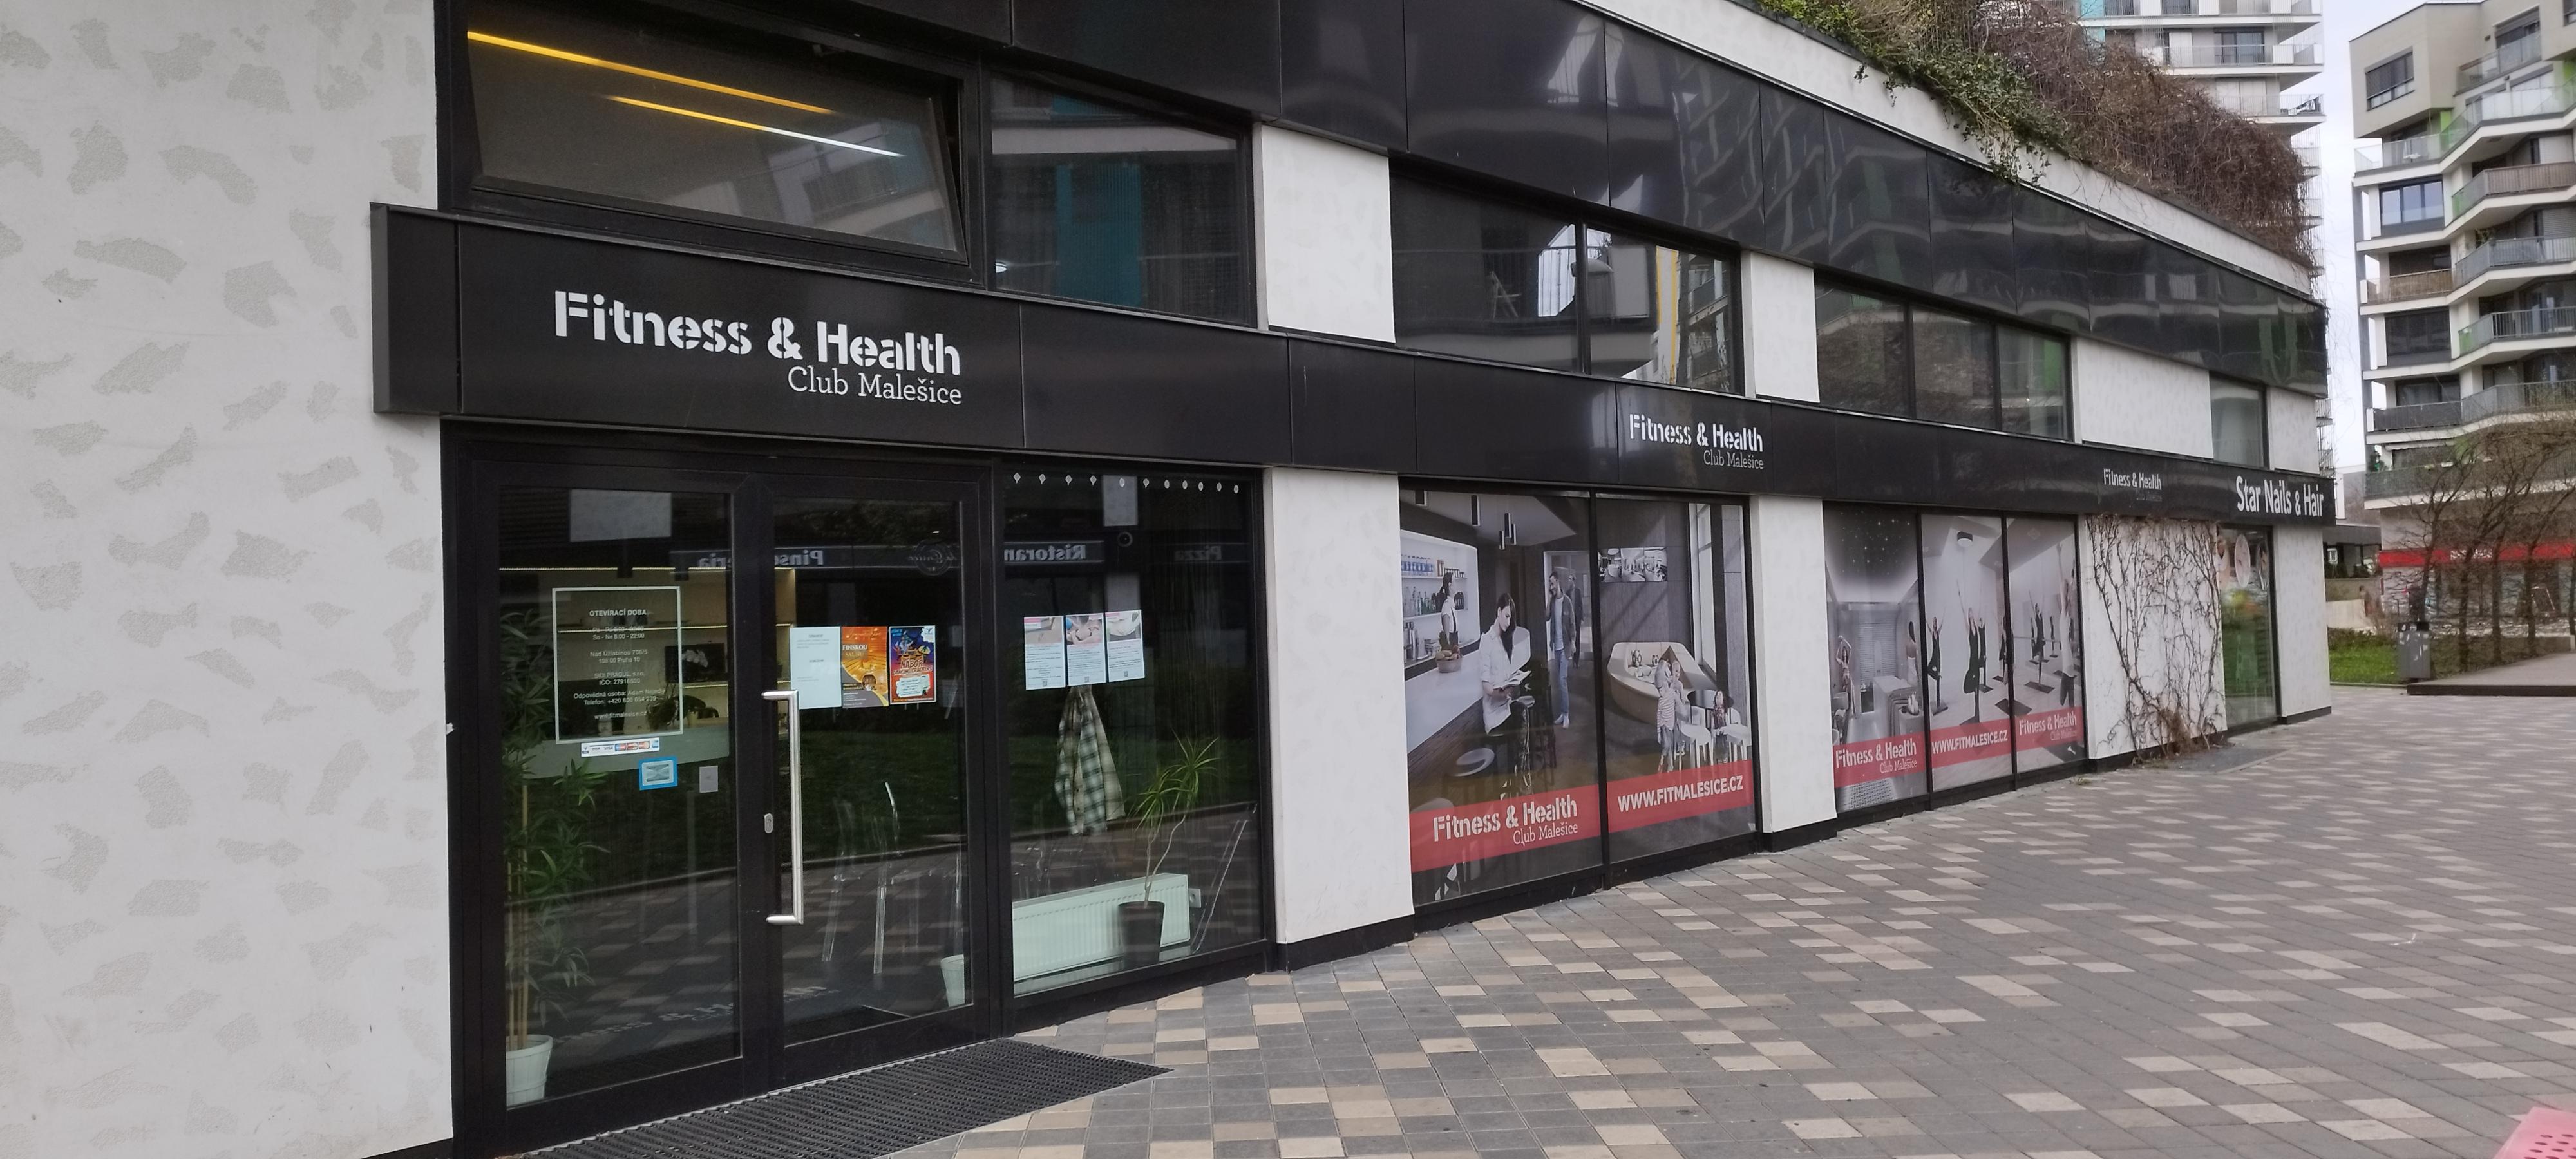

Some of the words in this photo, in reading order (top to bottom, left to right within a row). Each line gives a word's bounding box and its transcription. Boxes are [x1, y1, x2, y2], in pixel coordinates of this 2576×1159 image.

[554, 290, 752, 355] Fitness
[768, 317, 802, 359] &
[817, 321, 961, 375] Health
[788, 365, 849, 396] Club
[858, 372, 962, 404] Malešice
[1629, 413, 1692, 445] Fitness
[1696, 422, 1709, 447] &
[1712, 423, 1763, 452] Health
[1703, 449, 1725, 466] Club
[1727, 452, 1764, 469] Malešice
[2103, 468, 2130, 487] Fitness
[2132, 472, 2137, 487] &
[2139, 472, 2161, 490] Health
[2236, 475, 2261, 512] Star
[2264, 479, 2292, 514] Nails
[2295, 490, 2301, 516] &
[2304, 484, 2324, 516] Hair
[589, 608, 626, 617] OTEVÍRACÍ
[2019, 719, 2046, 735] Fitness
[2048, 715, 2052, 731] &
[2054, 711, 2077, 730] Health
[1835, 749, 1873, 768] Fitness
[1875, 744, 1883, 761] &
[1885, 737, 1917, 760] Health
[1932, 730, 2008, 754] WWW.FITMALESICE.CZ
[1880, 760, 1893, 773] Club
[1617, 775, 1743, 812] WWW.FITMALESICE.CZ
[1434, 813, 1501, 842] Fitness
[1506, 804, 1519, 829] &
[1523, 794, 1577, 825] Health
[1513, 827, 1536, 846] Club
[1539, 822, 1578, 840] Malešice
